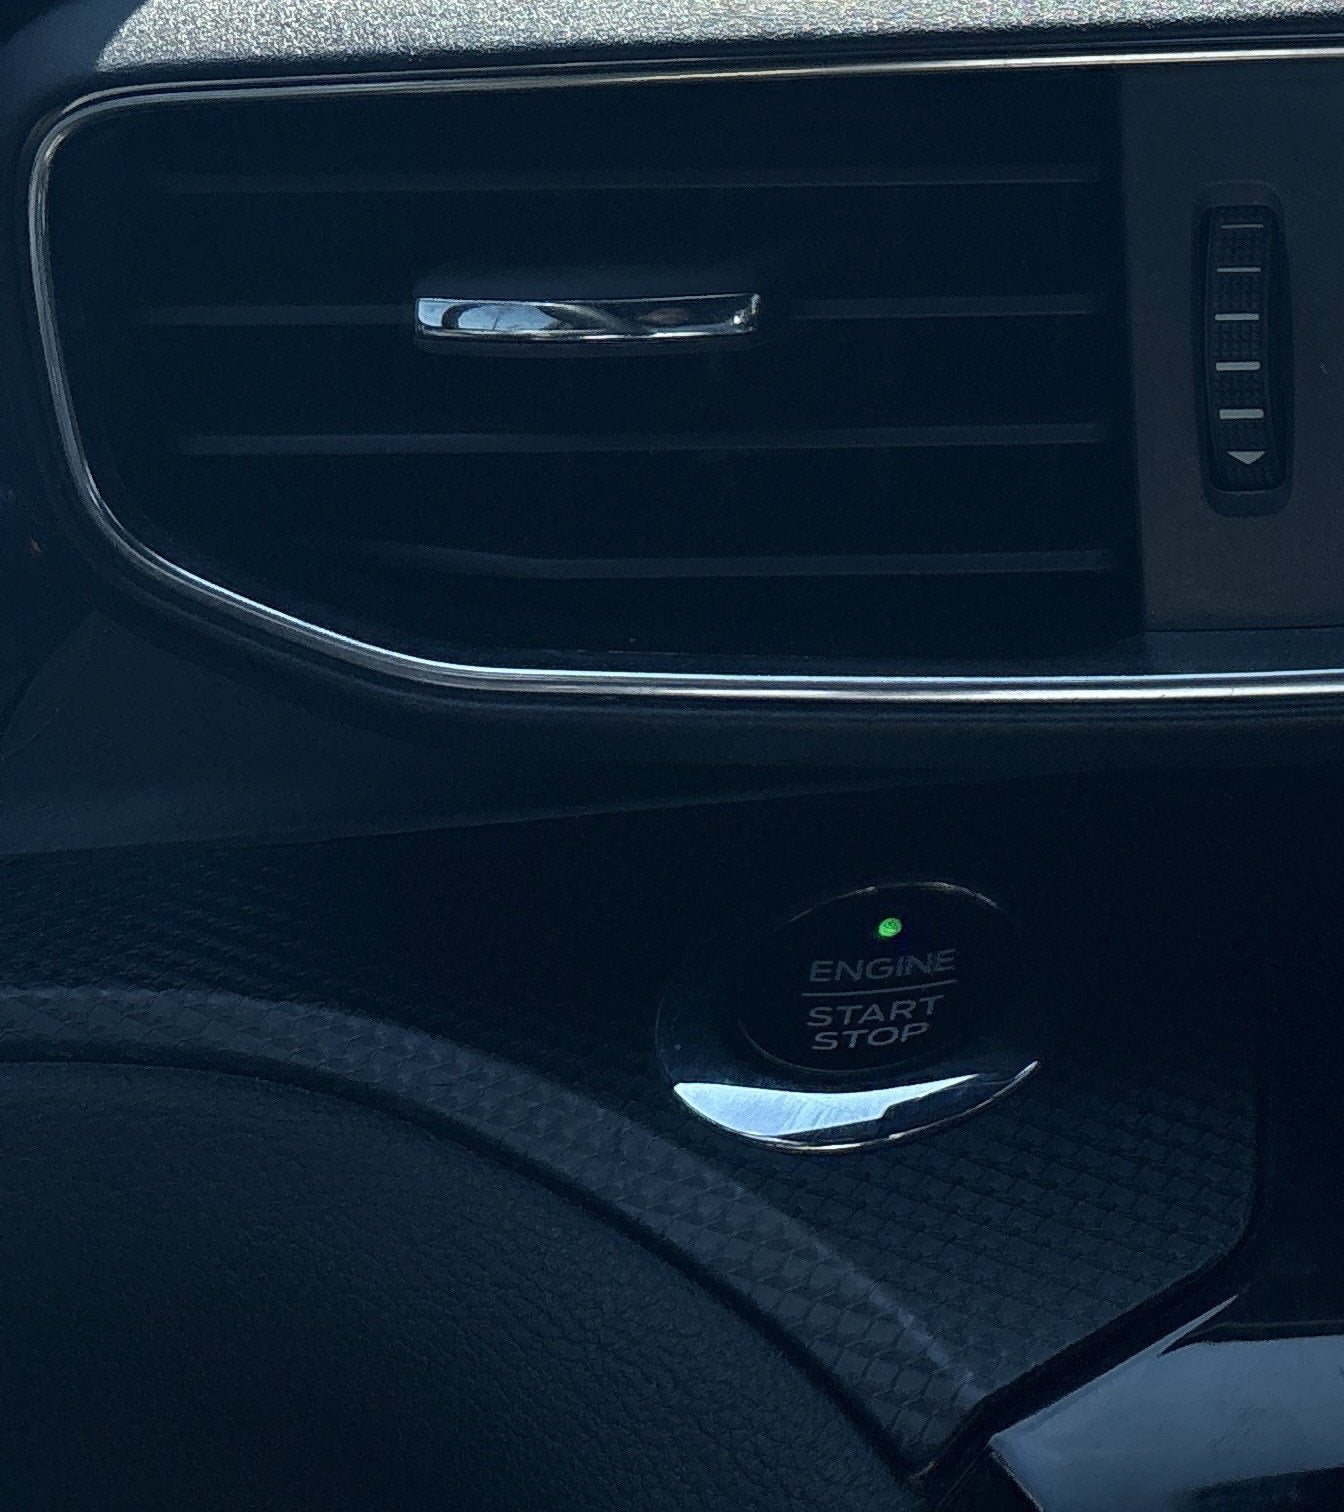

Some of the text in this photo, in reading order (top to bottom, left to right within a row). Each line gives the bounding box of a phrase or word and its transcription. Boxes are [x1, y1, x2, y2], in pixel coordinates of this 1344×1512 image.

[808, 948, 957, 983] ENGINE
[806, 994, 945, 1028] START
[811, 1021, 930, 1051] STOP
